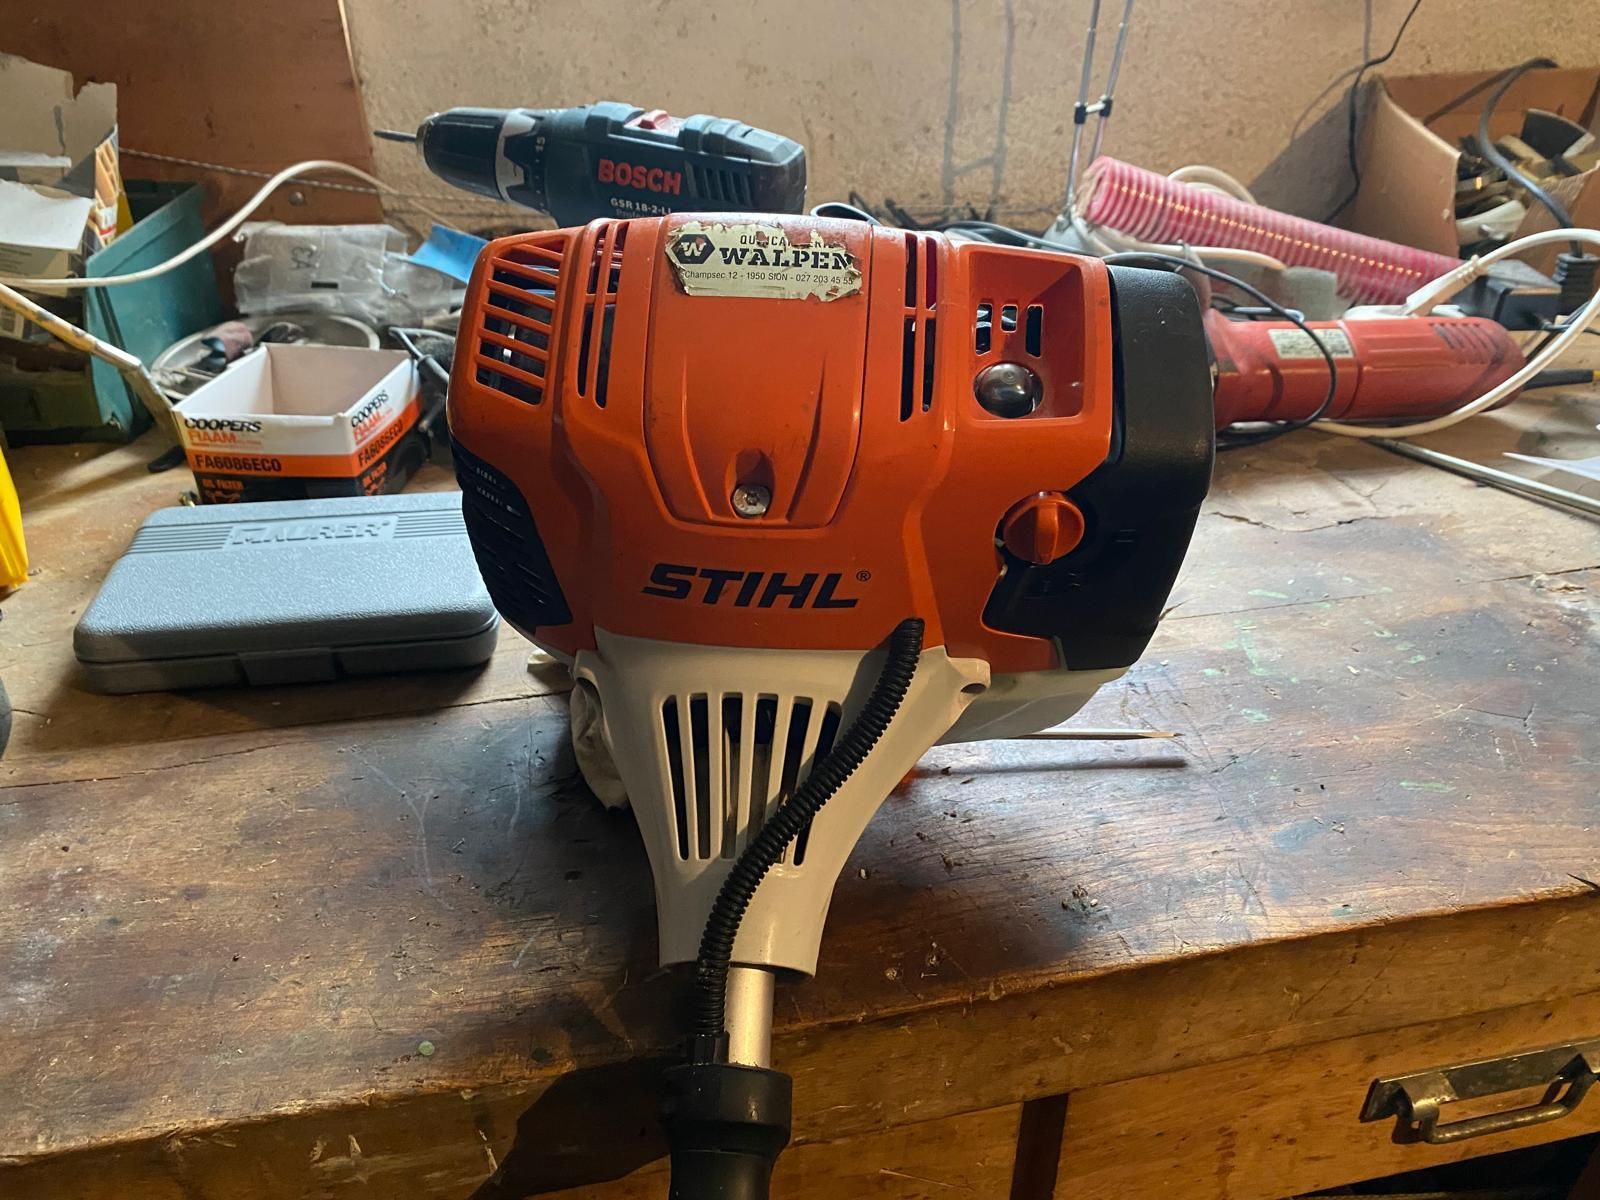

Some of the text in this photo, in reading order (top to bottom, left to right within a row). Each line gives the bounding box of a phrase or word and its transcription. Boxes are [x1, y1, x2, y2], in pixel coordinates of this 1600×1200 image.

[598, 158, 682, 195] BOSCH
[610, 198, 633, 210] GSR
[719, 247, 853, 270] WALPEN
[684, 270, 726, 280] Champsec
[729, 271, 738, 280] 12
[747, 271, 766, 280] 1950
[796, 274, 811, 283] 027
[813, 275, 828, 284] 203
[831, 276, 841, 285] 45
[843, 276, 854, 286] 55
[351, 392, 390, 428] COOPERS
[184, 417, 262, 433] COOPERS
[188, 430, 238, 444] FIAAM
[195, 454, 282, 473] FA6086ECO
[640, 562, 860, 609] STIHL
